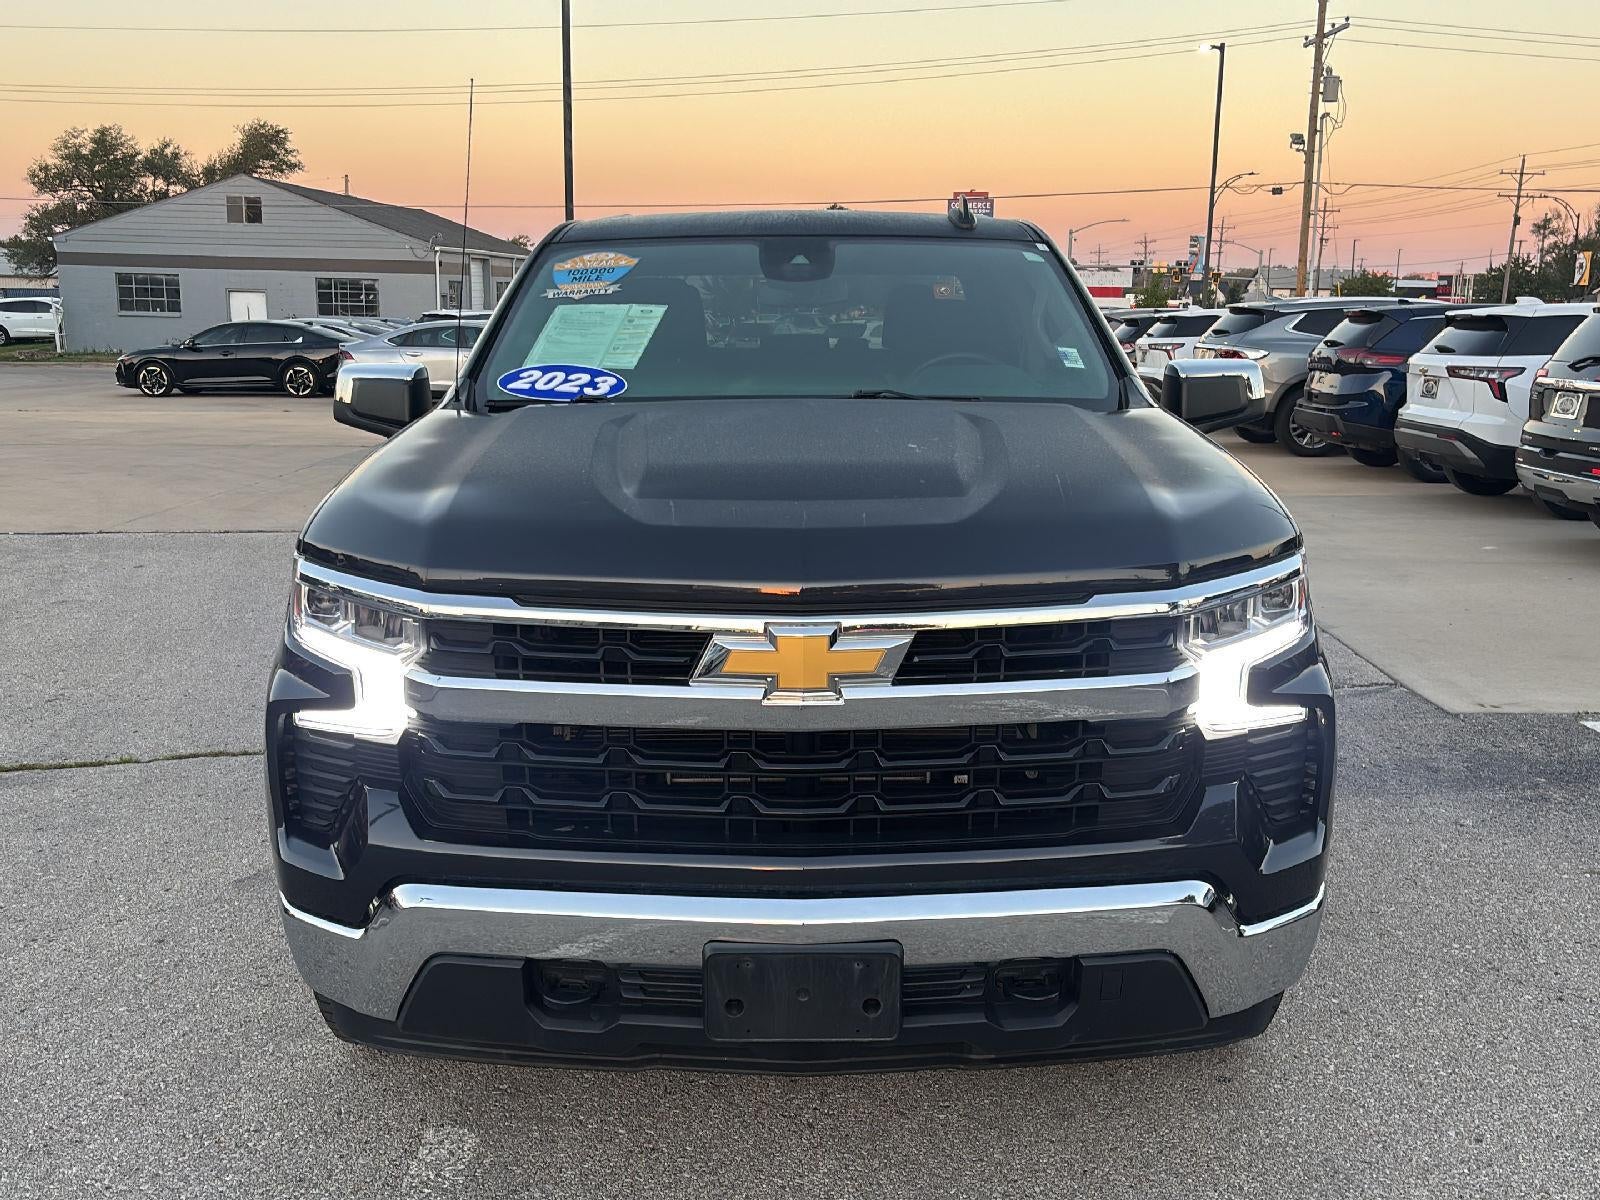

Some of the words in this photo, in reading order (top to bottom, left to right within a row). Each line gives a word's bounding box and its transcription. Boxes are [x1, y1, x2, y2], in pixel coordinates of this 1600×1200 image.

[570, 275, 602, 283] MILE
[552, 289, 609, 297] WARRANTY
[506, 370, 618, 396] 2023
